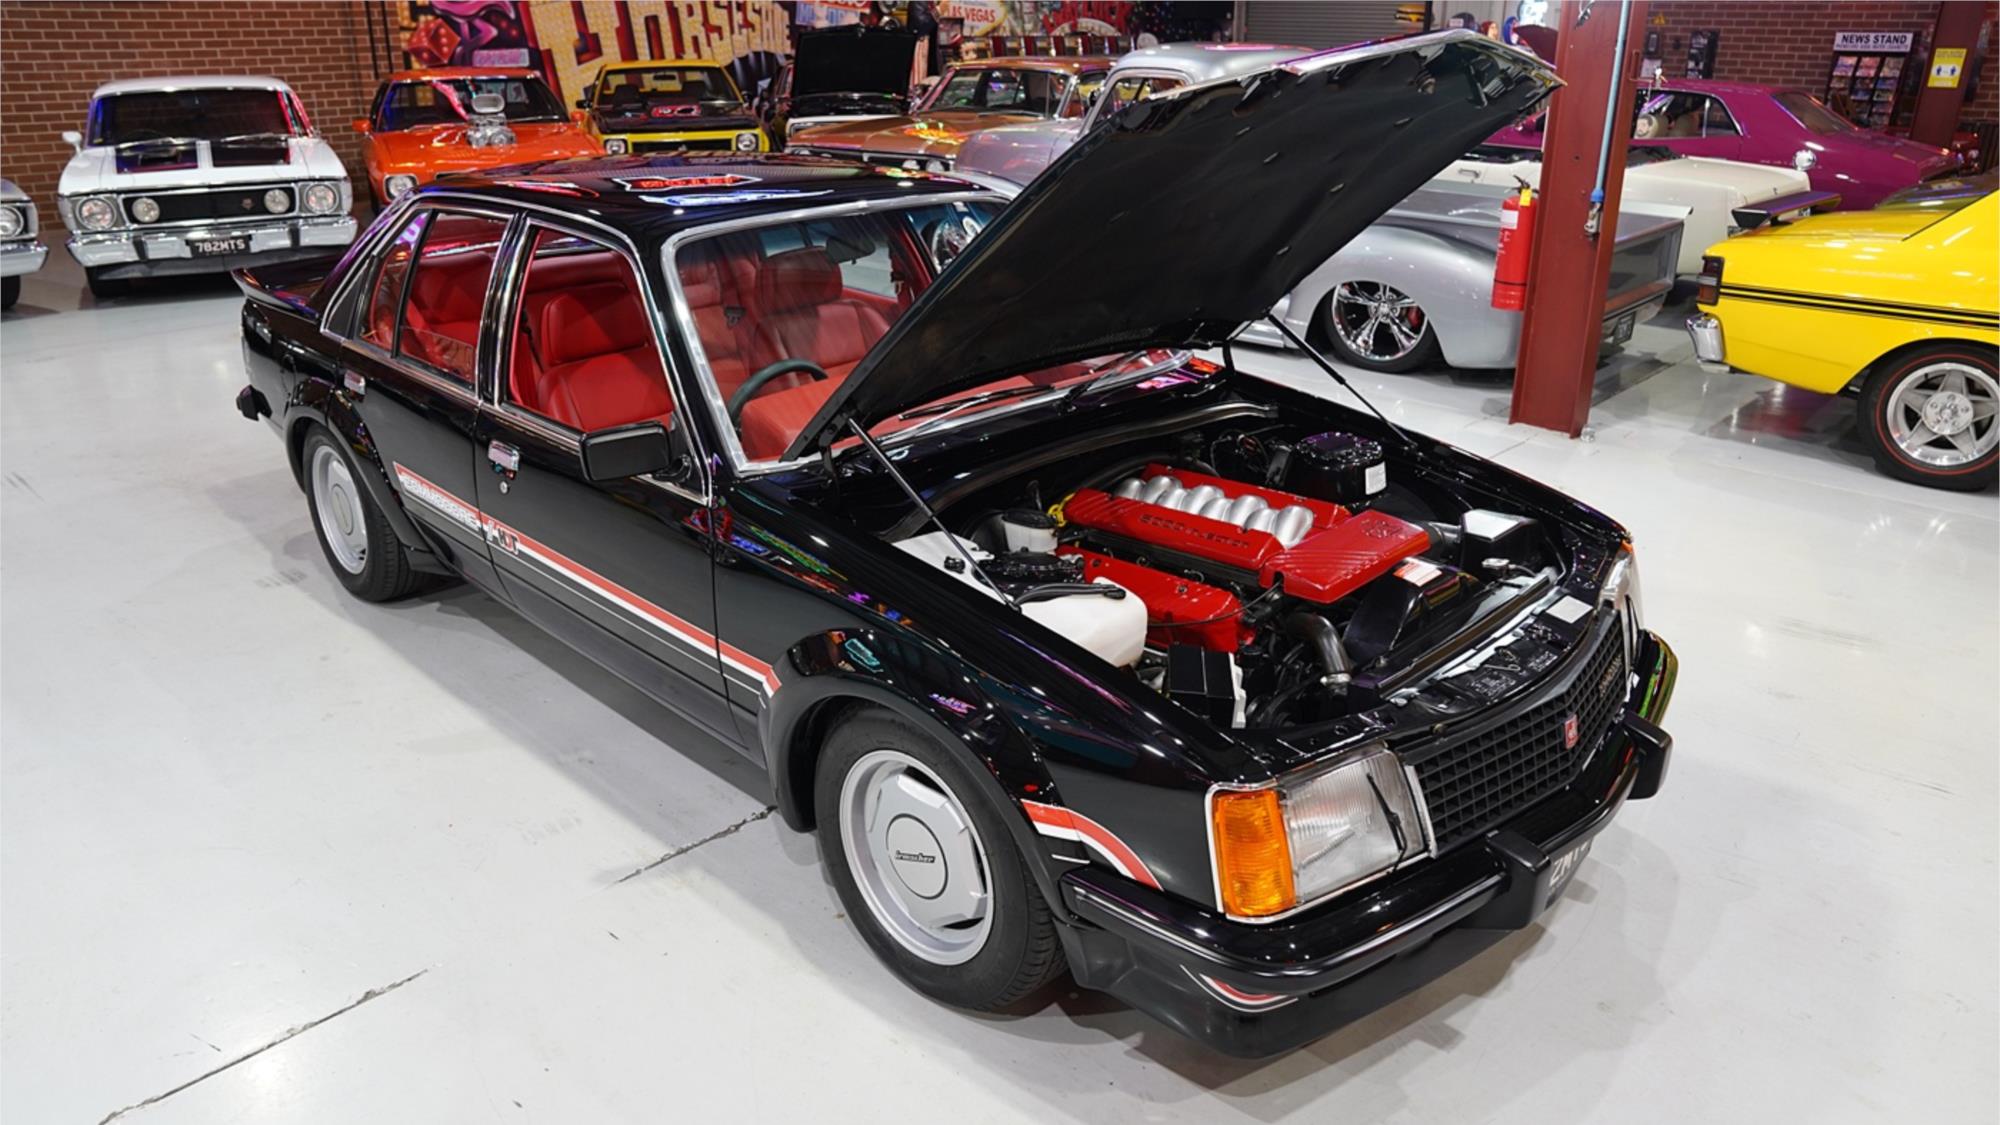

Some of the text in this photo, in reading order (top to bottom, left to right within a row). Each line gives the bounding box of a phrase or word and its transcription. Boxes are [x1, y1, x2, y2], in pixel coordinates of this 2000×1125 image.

[964, 7, 996, 24] VEGAS
[1841, 34, 1908, 45] NEWS STAND
